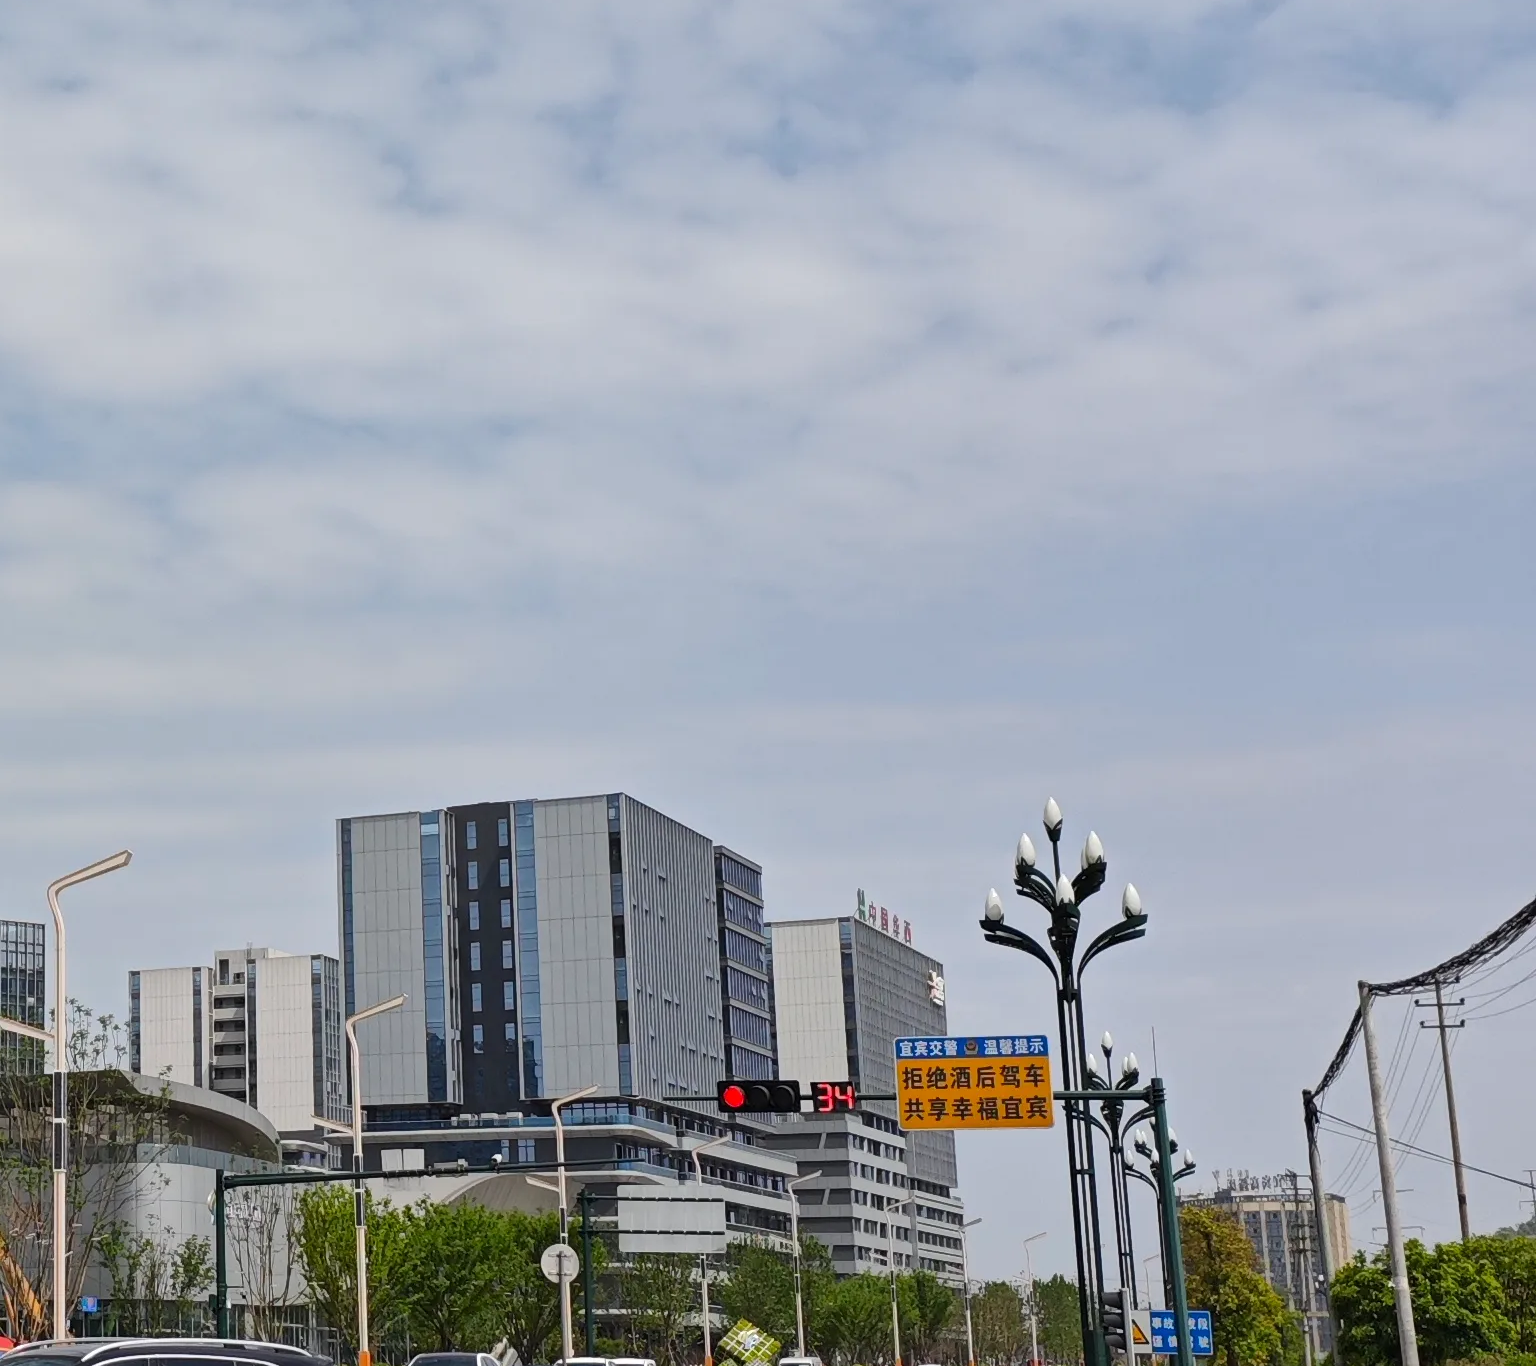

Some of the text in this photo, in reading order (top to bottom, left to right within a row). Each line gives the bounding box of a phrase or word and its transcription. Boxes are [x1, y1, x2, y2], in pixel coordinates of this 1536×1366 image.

[899, 1038, 1045, 1057] 宜宾交警 温馨提示
[902, 1064, 1046, 1090] 拒绝酒后驾车
[817, 1084, 853, 1112] 34
[904, 1095, 1048, 1122] 共享幸福宜宾
